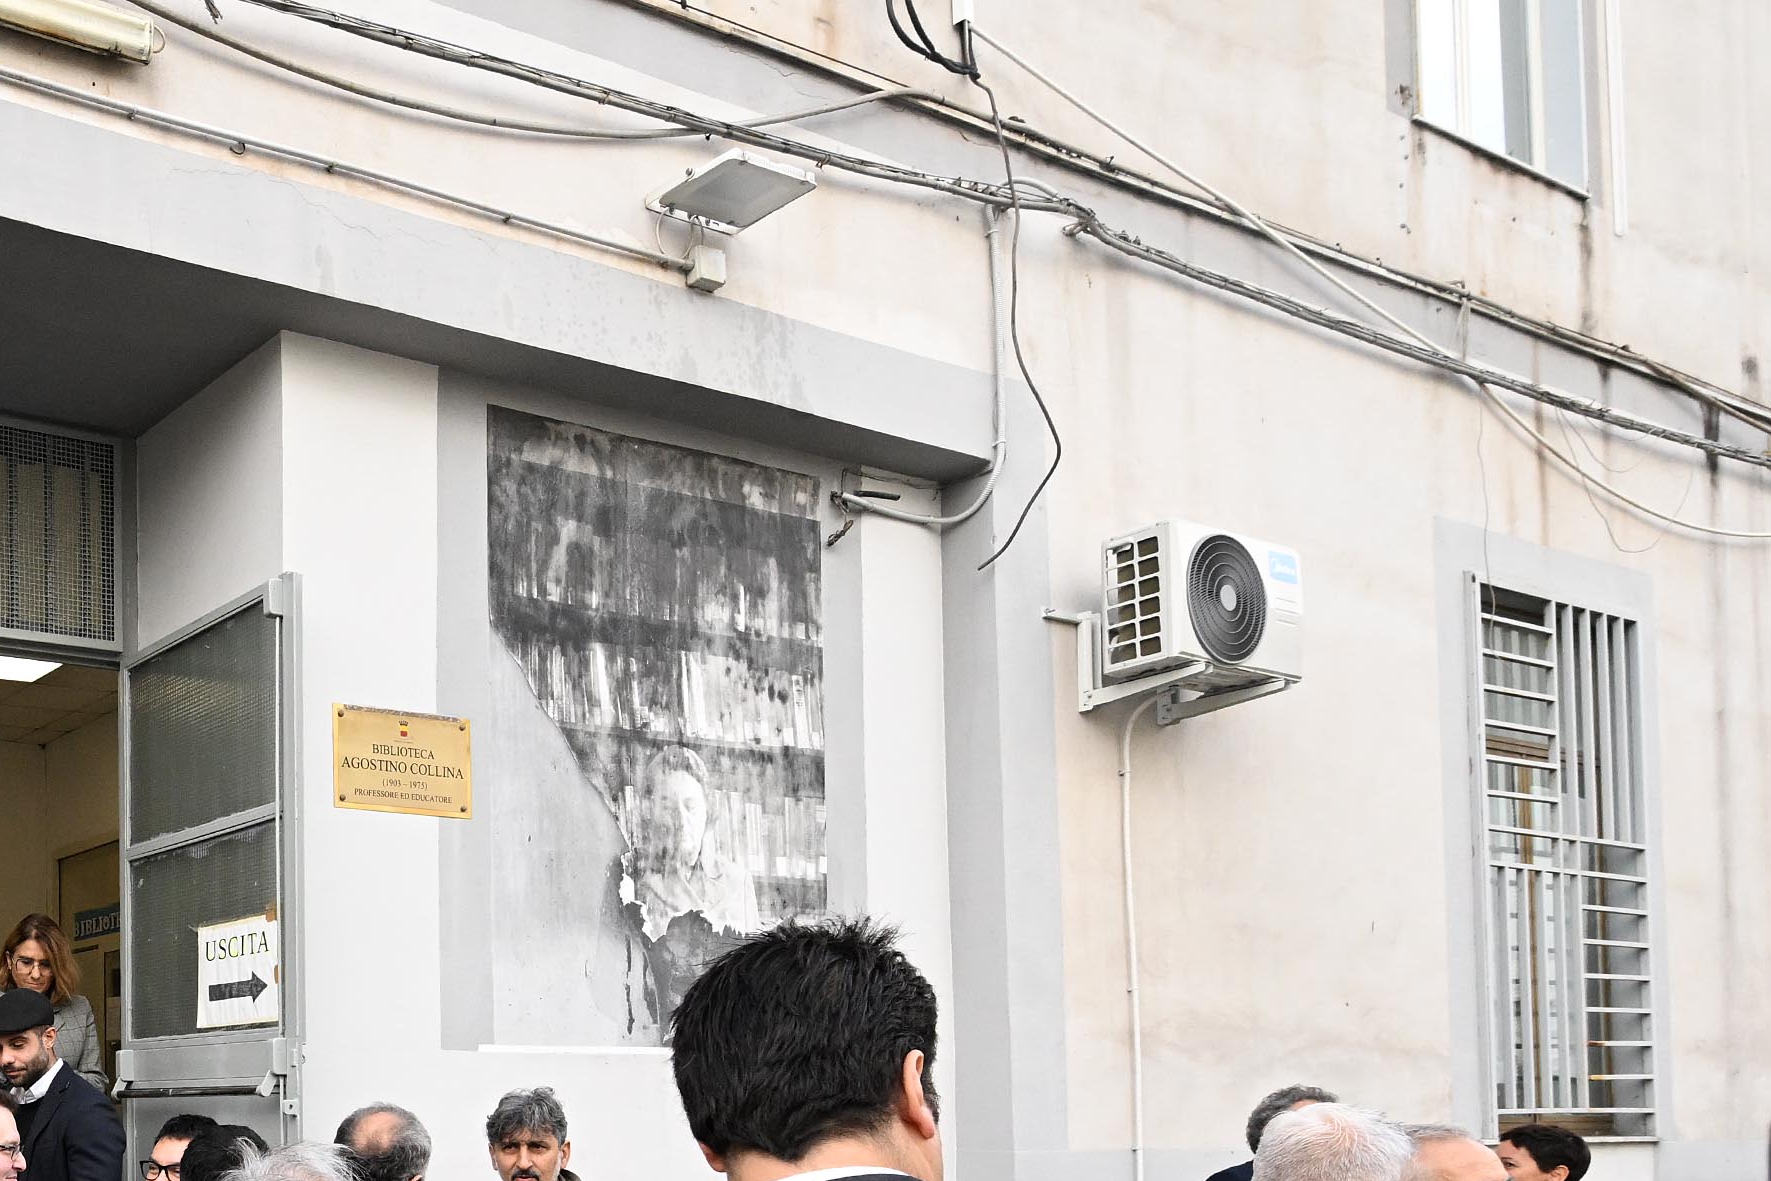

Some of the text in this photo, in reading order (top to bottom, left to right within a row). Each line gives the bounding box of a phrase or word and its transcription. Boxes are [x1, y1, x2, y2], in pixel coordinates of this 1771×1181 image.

[372, 743, 435, 760] BIBLIOTECA
[341, 756, 464, 780] AGOSTINO COLLINA
[382, 778, 401, 787] (1903
[409, 780, 428, 791] 1975)
[354, 788, 453, 804] PROFESSORE ED EDUCATORE
[205, 930, 269, 962] USCITA
